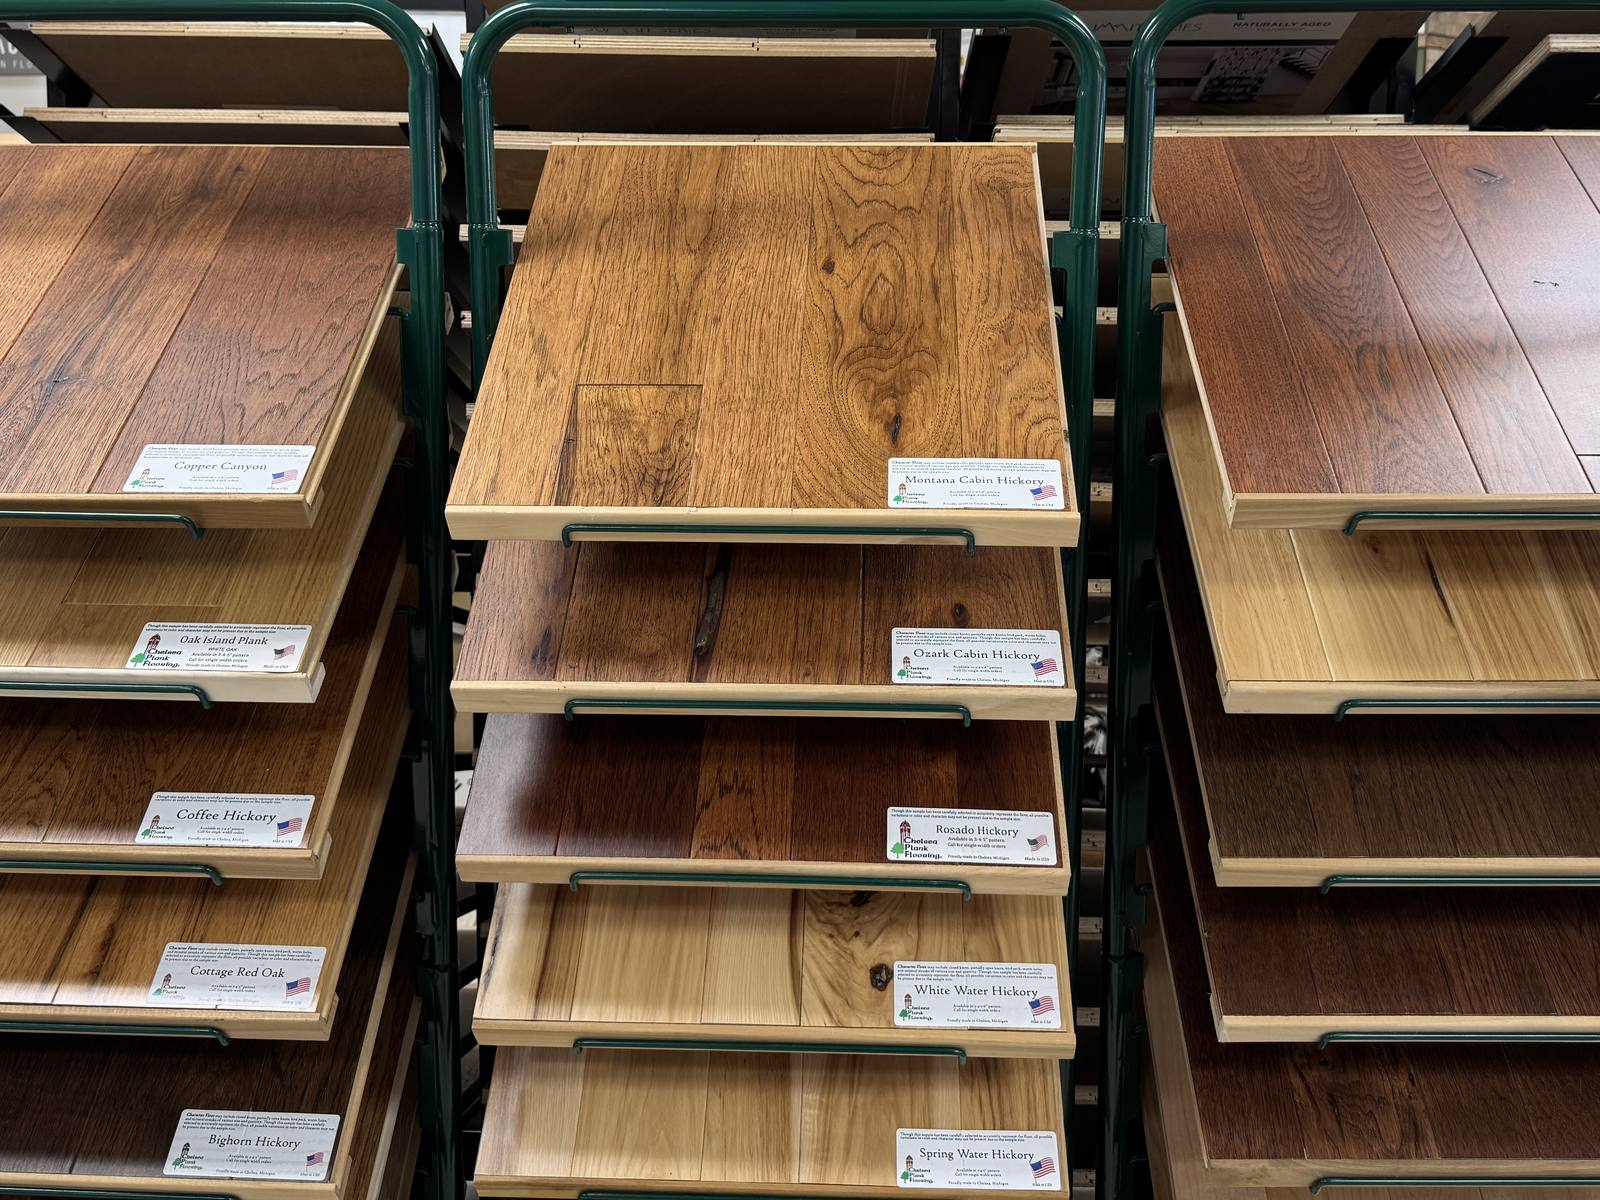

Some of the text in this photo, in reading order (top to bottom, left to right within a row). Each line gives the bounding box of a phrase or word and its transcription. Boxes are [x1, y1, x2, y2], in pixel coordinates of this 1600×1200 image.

[174, 461, 267, 472] Copper Canyon
[905, 475, 1044, 486] Montana Cabin Hickory
[180, 636, 268, 645] Oak Island Plank
[914, 649, 1040, 661] Ozark Cabin Hickory
[177, 809, 276, 824] Coffee Hickory
[936, 825, 1019, 838] Rosado Hickory
[190, 966, 285, 978] Cottage Red Oak
[915, 985, 1038, 999] White Water Hickory
[208, 1134, 301, 1150] Bighorn Hickory
[919, 1148, 1034, 1162] Spring Water Hickory
